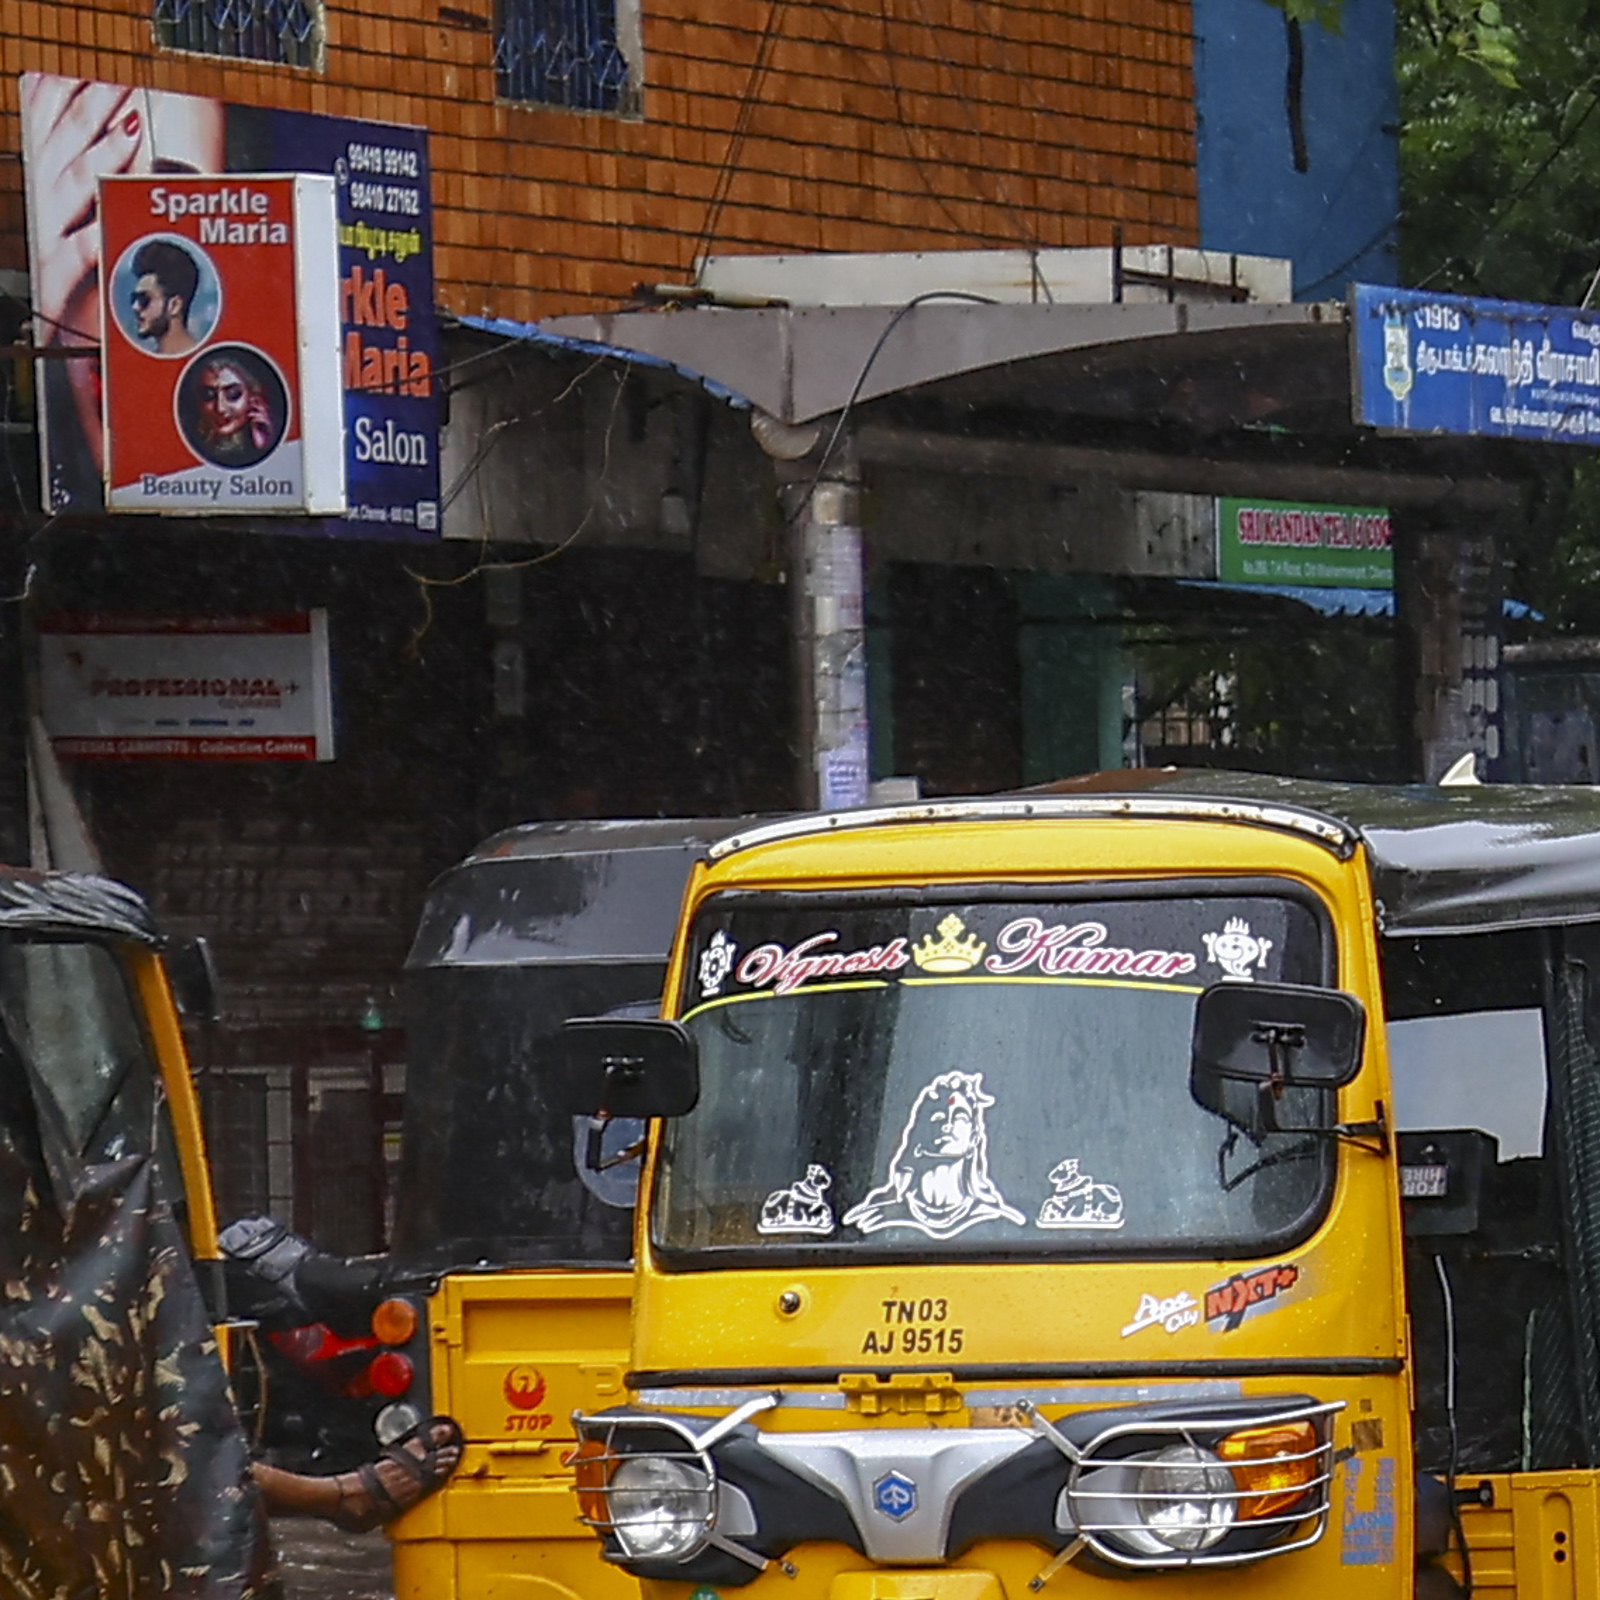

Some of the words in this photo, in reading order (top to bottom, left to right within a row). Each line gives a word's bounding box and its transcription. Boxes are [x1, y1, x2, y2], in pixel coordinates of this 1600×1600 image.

[150, 187, 268, 223] Sparkle
[199, 217, 288, 244] Maria
[341, 266, 408, 330] rkle
[1424, 304, 1461, 331] 1913
[355, 417, 428, 465] Salon
[142, 475, 222, 500] Beauty
[229, 474, 293, 496] Salon
[1237, 508, 1261, 544] SRI
[1262, 508, 1322, 547] KANDAN
[1323, 511, 1353, 549] TEA
[90, 678, 282, 697] PROFESSIONAL
[736, 931, 911, 995] Vignesh
[984, 917, 1197, 978] Kumar
[1403, 1168, 1442, 1181] HIRE
[1403, 1182, 1439, 1195] FOR
[882, 1300, 914, 1324] TN
[919, 1298, 948, 1323] 03
[1121, 1291, 1197, 1338] Ape
[1165, 1309, 1199, 1333] City
[1205, 1264, 1298, 1322] NXT+
[861, 1330, 894, 1355] AJ
[901, 1327, 964, 1353] 9515
[505, 1414, 553, 1432] STOP
